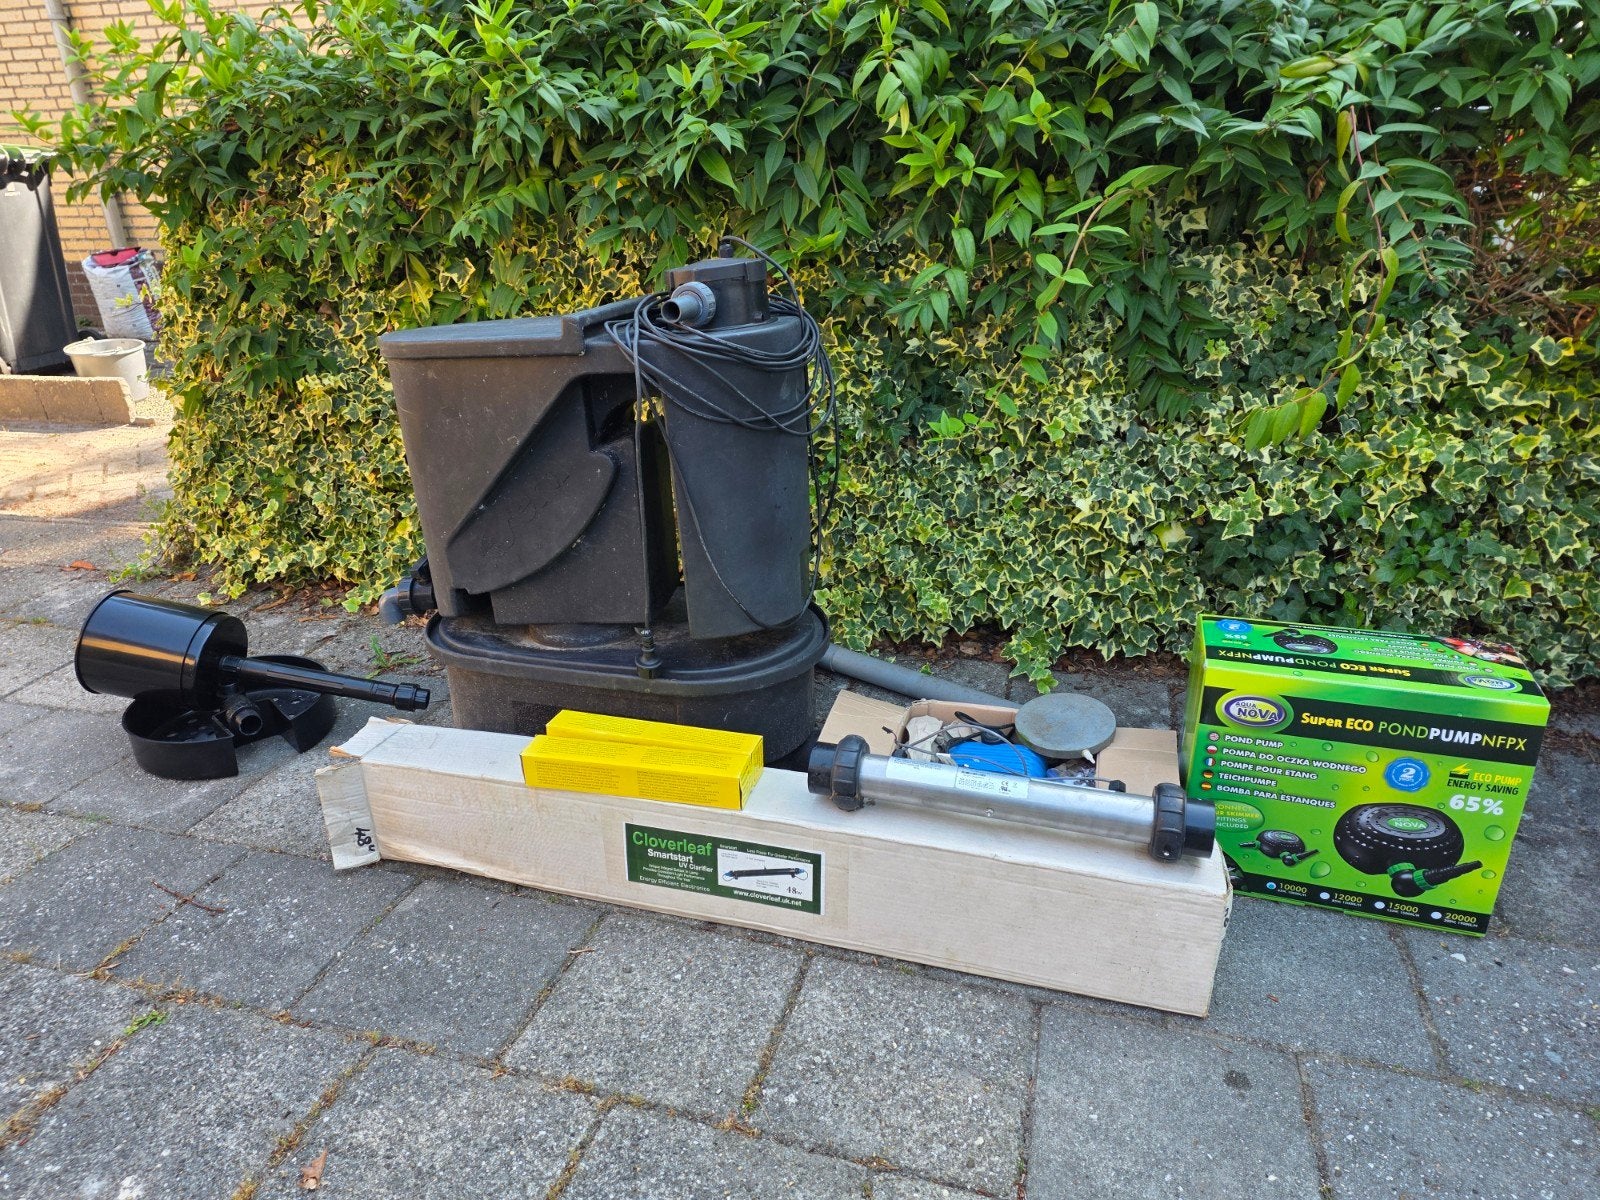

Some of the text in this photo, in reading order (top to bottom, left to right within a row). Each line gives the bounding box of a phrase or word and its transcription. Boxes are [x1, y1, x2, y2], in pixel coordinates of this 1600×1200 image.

[1340, 662, 1367, 672] ECO
[1235, 701, 1257, 709] AQUA
[1237, 708, 1279, 721] NOVA
[1345, 717, 1374, 732] ECO
[1224, 734, 1284, 749] POND PUMP
[1222, 747, 1367, 774] POMPA DO OCZKA WODNEGO
[1220, 760, 1318, 780] POMPE POUR ETANG
[1400, 767, 1416, 778] 2
[1219, 772, 1277, 787] TEICHPUMPE
[1473, 772, 1522, 786] ECO PUMP
[1447, 778, 1519, 795] ENERGY SAVING
[1217, 784, 1336, 809] BOMBA PARA ESTANQUES
[1449, 794, 1504, 816] 65%
[1227, 811, 1260, 819] SKIMMER
[1394, 821, 1427, 829] NOVA
[632, 831, 713, 856] Cloverleaf
[647, 848, 694, 863] Smartstart
[689, 863, 714, 873] Clarifier
[639, 875, 657, 884] Energy
[1279, 882, 1308, 894] 10000
[1333, 892, 1363, 903] 12000
[1388, 902, 1419, 913] 15000
[1445, 912, 1477, 924] 20000
